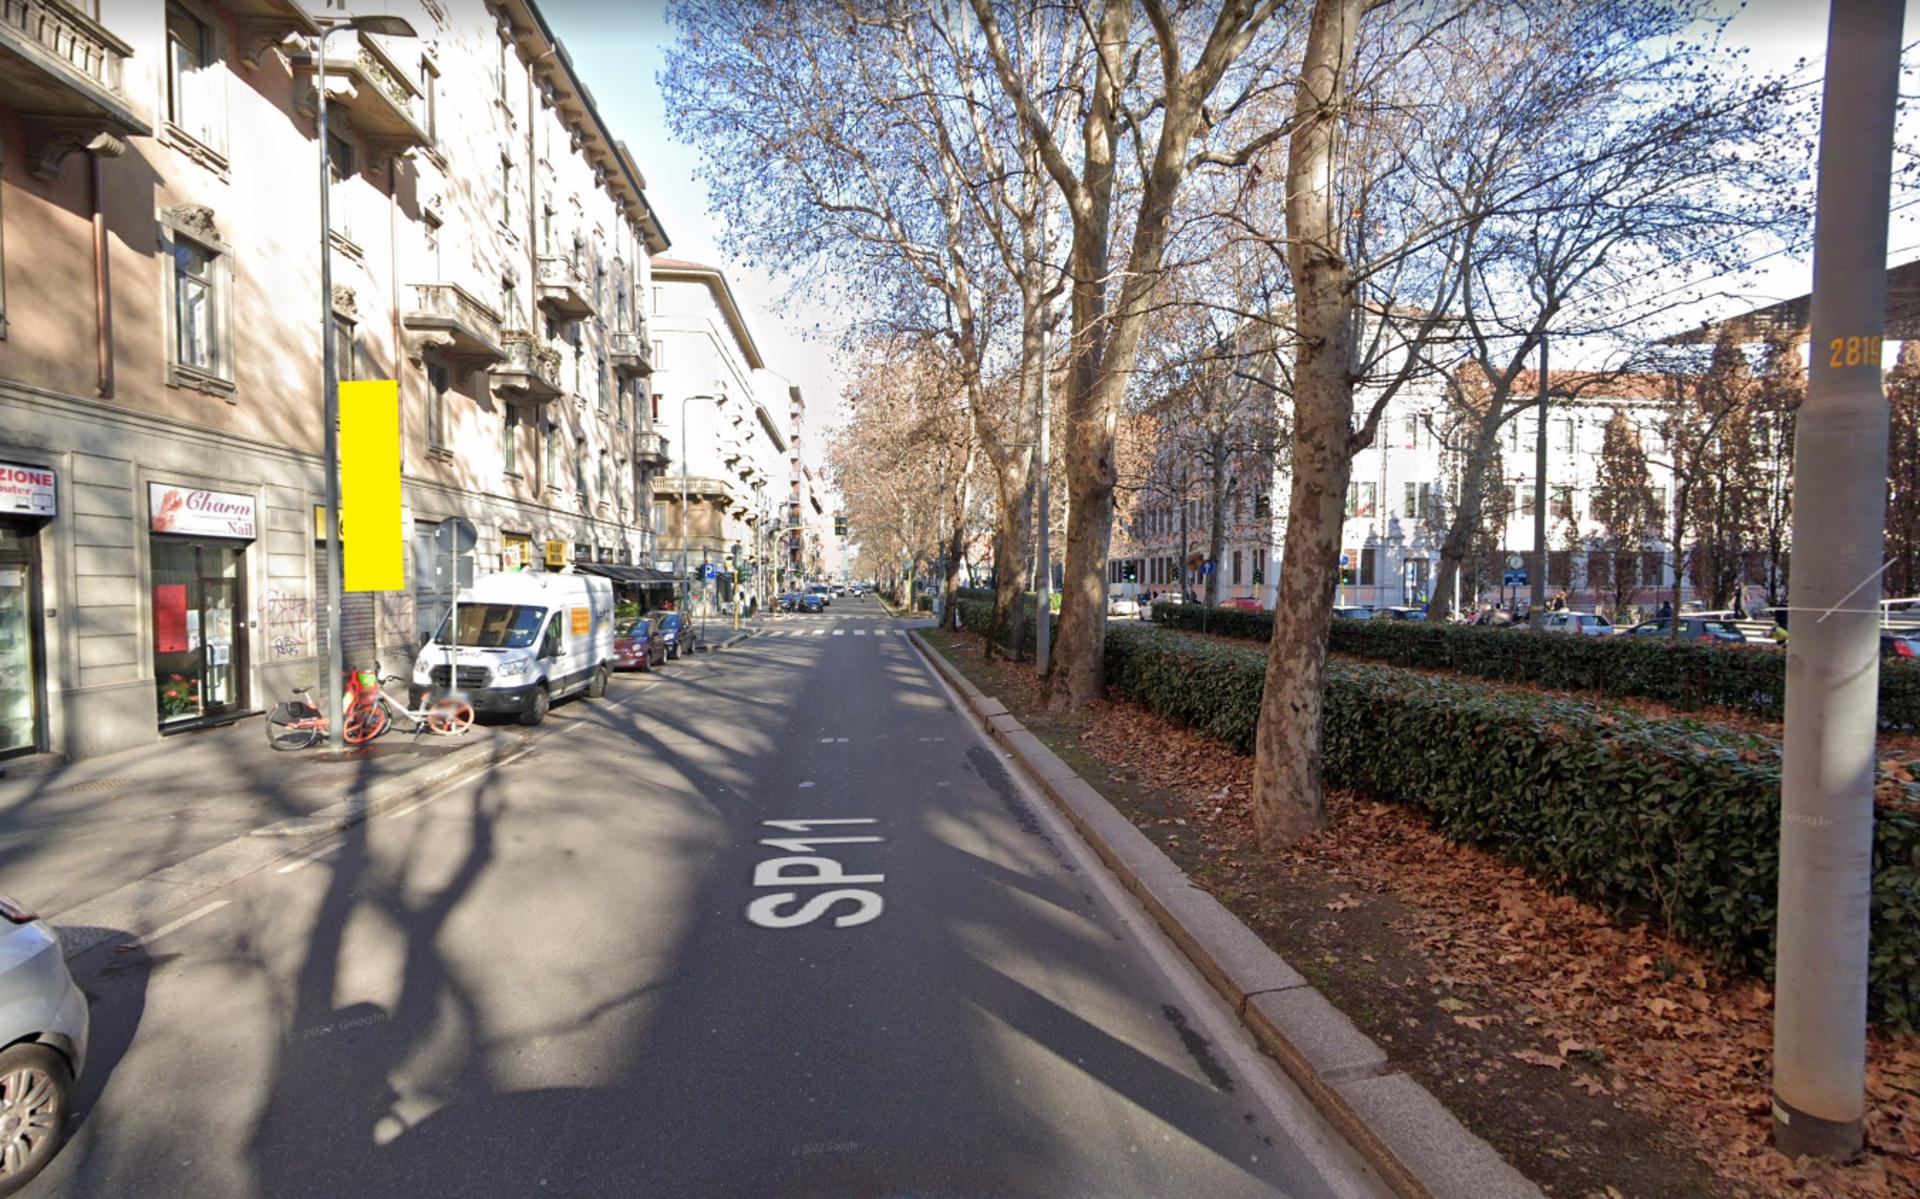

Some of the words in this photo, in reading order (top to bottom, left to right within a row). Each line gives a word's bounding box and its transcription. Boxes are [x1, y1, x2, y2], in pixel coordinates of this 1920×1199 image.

[186, 490, 250, 515] Charm
[227, 521, 253, 536] Nail
[704, 565, 713, 578] P
[746, 817, 885, 929] SP11
